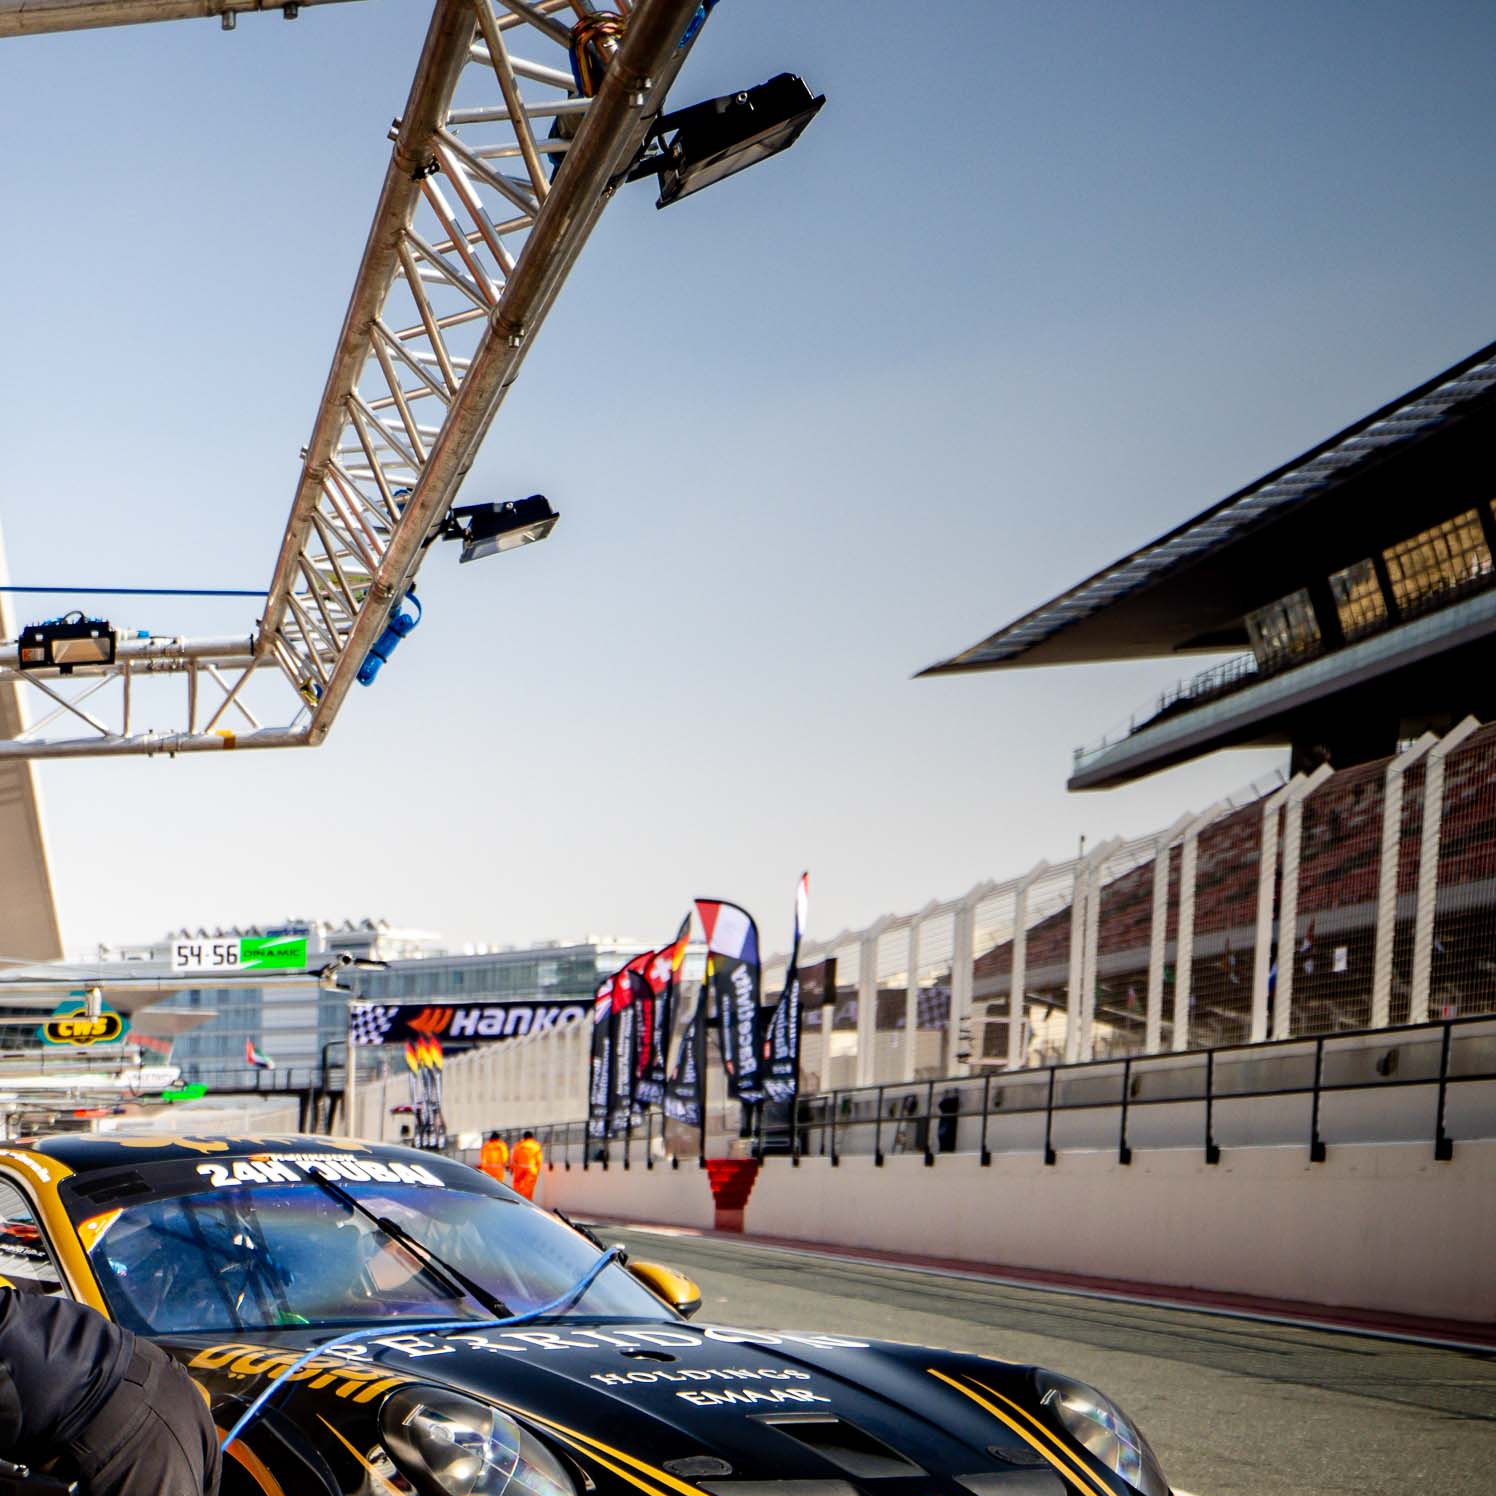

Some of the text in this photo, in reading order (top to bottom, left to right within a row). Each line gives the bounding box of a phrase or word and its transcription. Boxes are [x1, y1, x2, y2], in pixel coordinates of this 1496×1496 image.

[196, 1160, 447, 1188] 24H DUBAI
[590, 1368, 812, 1387] HOLDINGS
[675, 1387, 831, 1407] EMAAR
